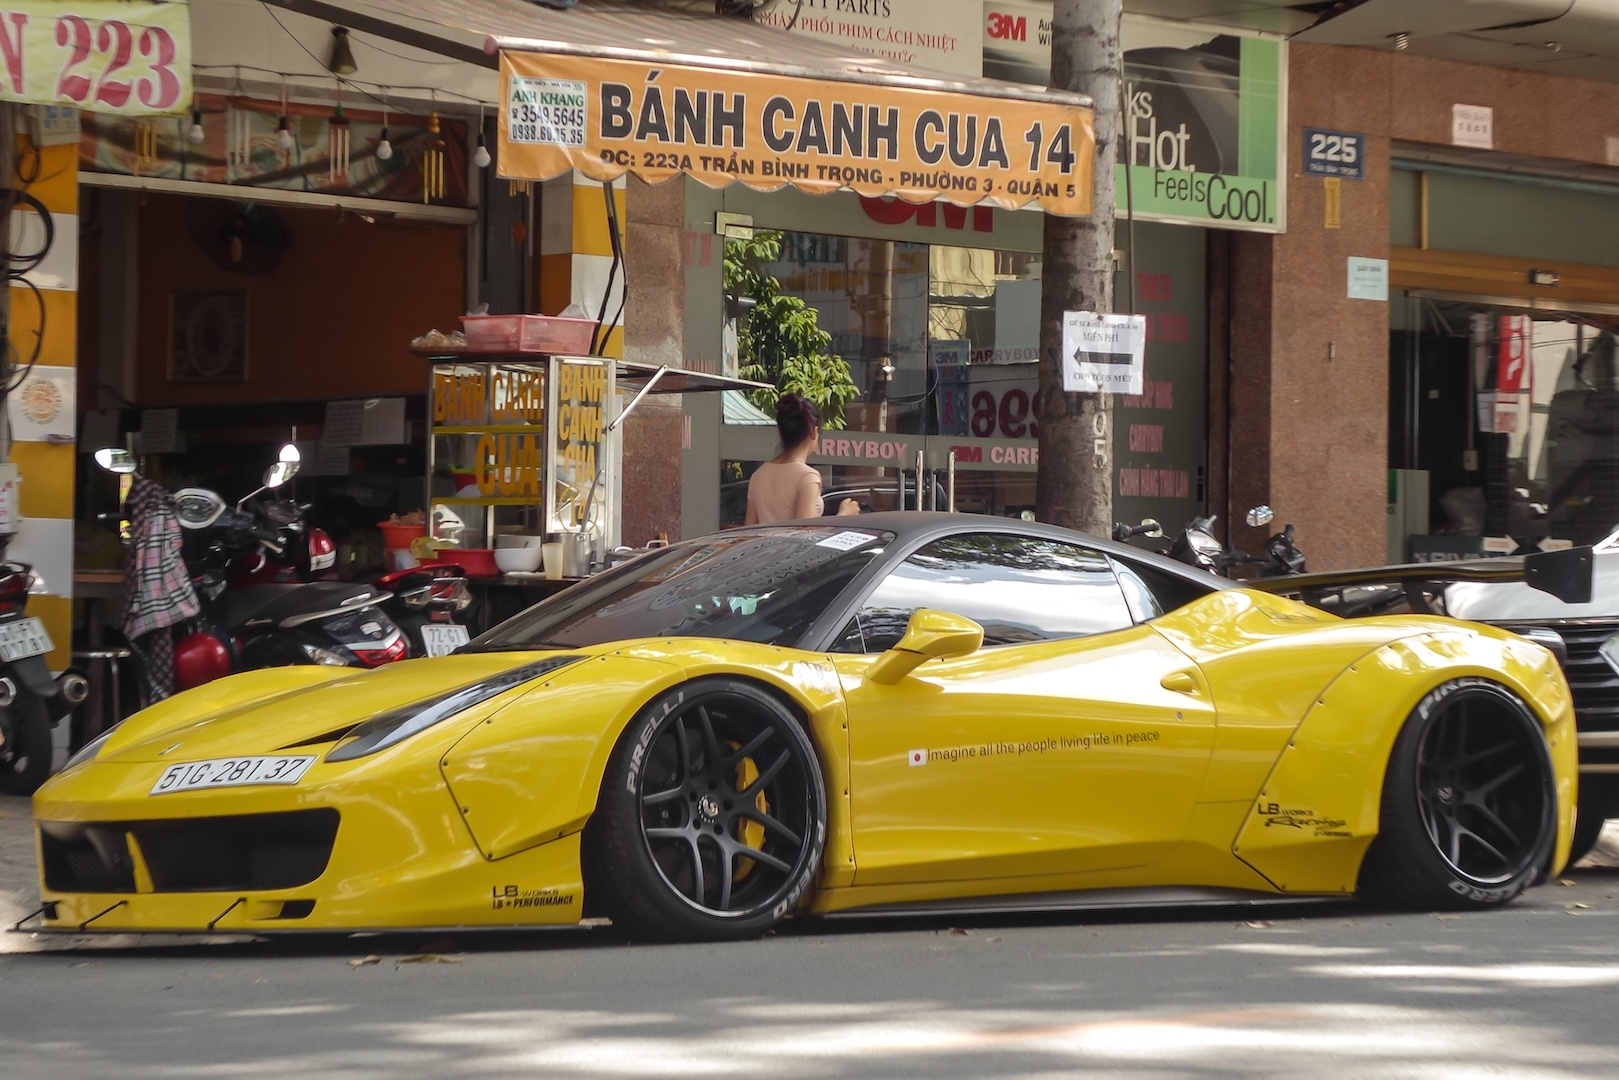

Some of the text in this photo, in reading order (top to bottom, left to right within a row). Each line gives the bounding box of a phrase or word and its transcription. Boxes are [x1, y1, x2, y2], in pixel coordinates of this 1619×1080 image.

[801, 15, 834, 34] PHỐI
[838, 23, 872, 39] PHIM
[876, 25, 914, 46] CÁCH
[916, 31, 957, 53] NHIỆT
[987, 11, 1027, 42] 3M
[55, 14, 180, 108] 223
[512, 90, 584, 107] ANH KHANG
[600, 70, 1075, 174] BÁNH CANH CUA 14
[1131, 117, 1196, 172] Hot.
[1311, 134, 1357, 163] 225
[600, 149, 635, 166] ĐC:
[643, 152, 692, 170] 223A
[699, 151, 754, 174] TRẦN
[761, 155, 809, 178] BÌNH
[816, 164, 883, 186] TRỌNG
[900, 170, 977, 191] PHƯỜNG
[982, 178, 993, 191] 3
[1066, 184, 1076, 198] 5
[492, 372, 545, 421] CANH
[557, 404, 601, 442] CANH
[475, 431, 540, 497] CUA
[564, 443, 596, 482] CUA
[811, 438, 908, 460] ARRYBOY
[626, 692, 684, 795] PIRELLI
[927, 730, 1160, 763] Imagine all the people living life in peace
[160, 758, 308, 790] 51G-281.37
[1258, 803, 1279, 815] LB
[492, 895, 574, 910] LB PERFORMANCE
[493, 885, 518, 898] LB
